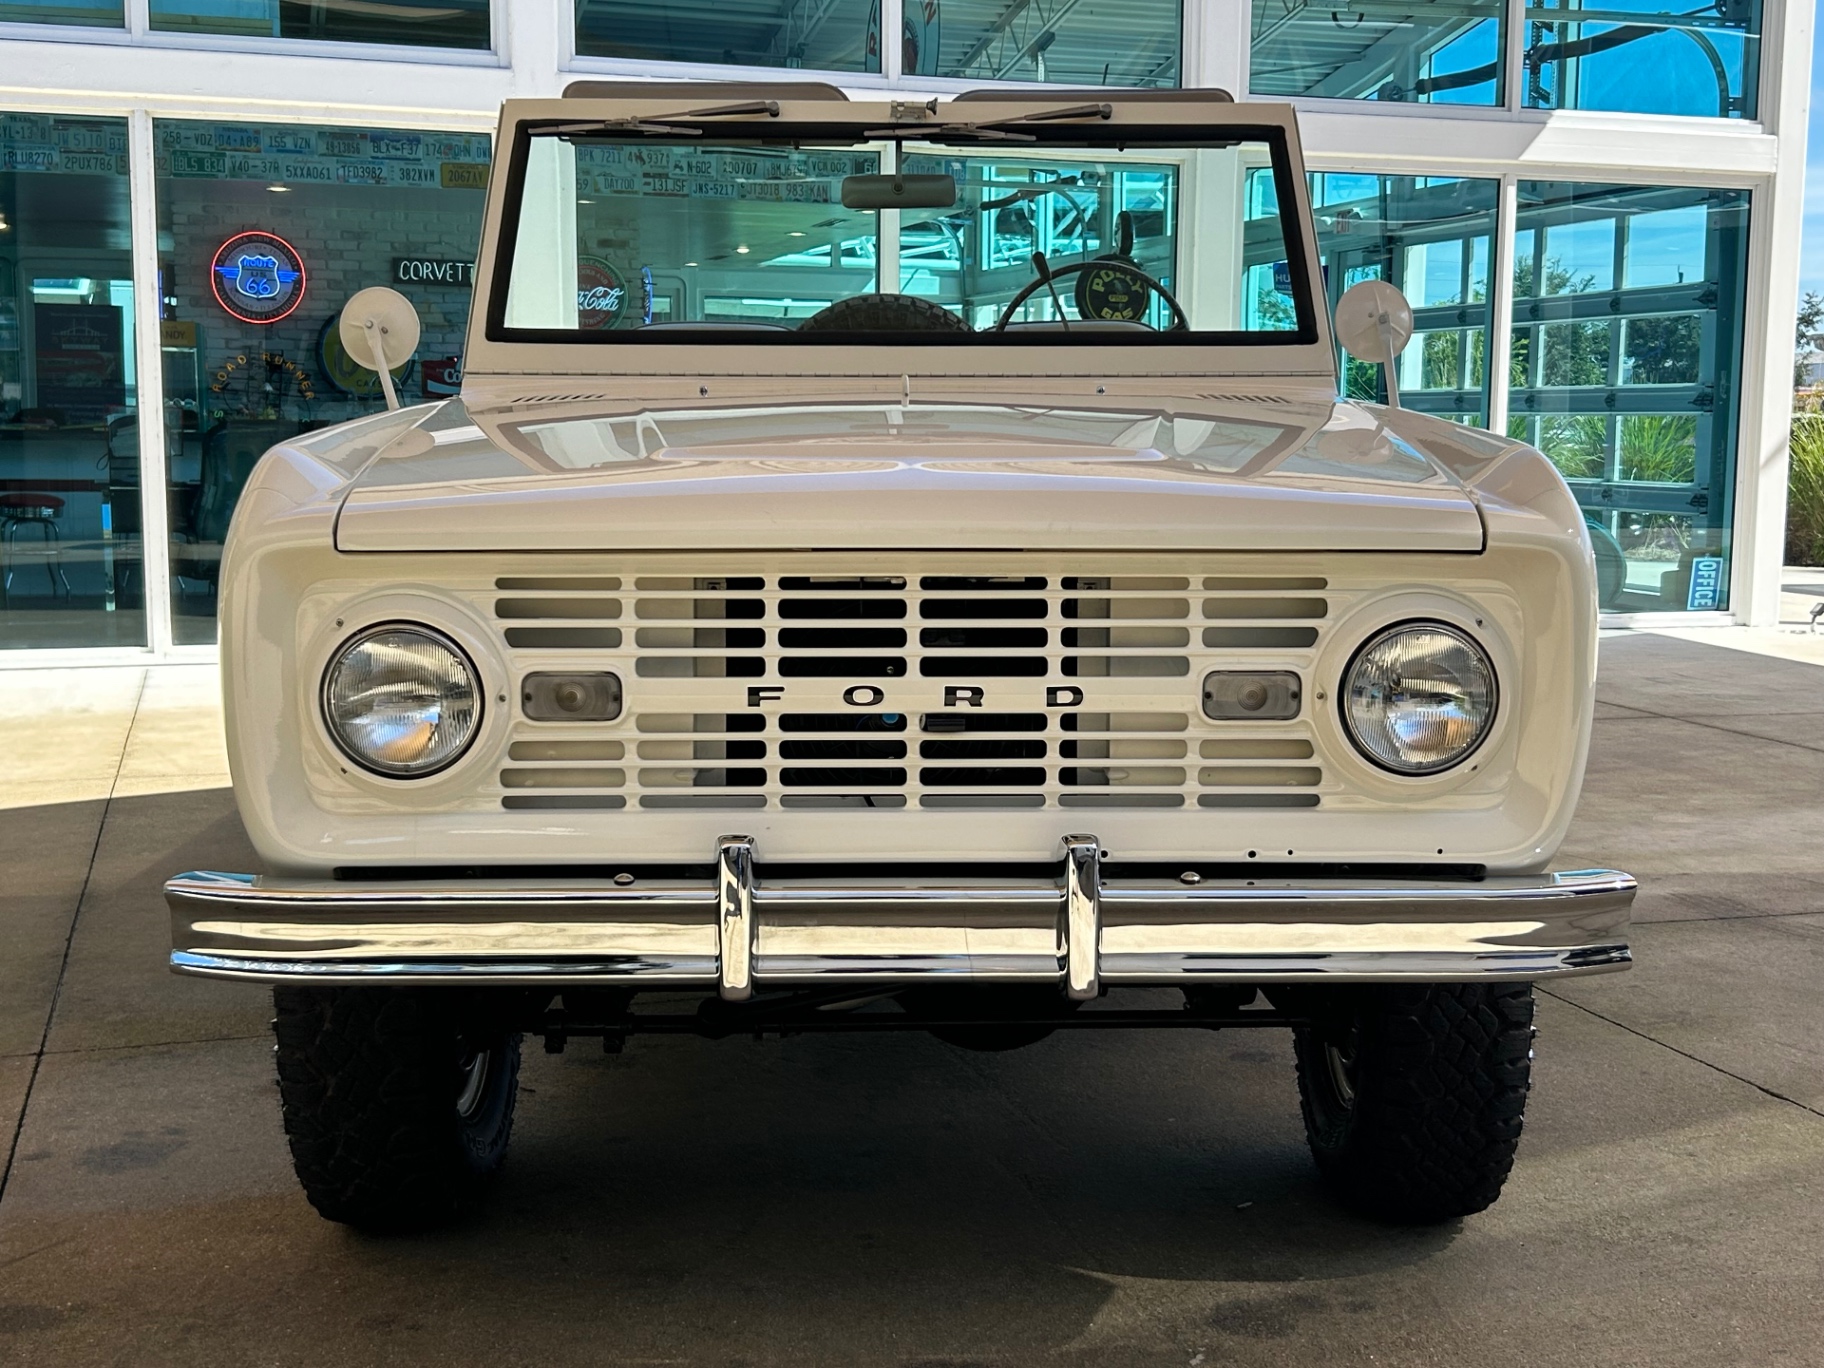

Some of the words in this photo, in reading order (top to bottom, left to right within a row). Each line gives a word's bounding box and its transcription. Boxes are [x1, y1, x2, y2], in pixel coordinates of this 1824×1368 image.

[243, 258, 275, 269] ROUTE
[246, 277, 272, 296] 66
[1100, 307, 1134, 321] GAS
[1693, 560, 1718, 607] OFFICE
[747, 685, 1084, 708] FORD
